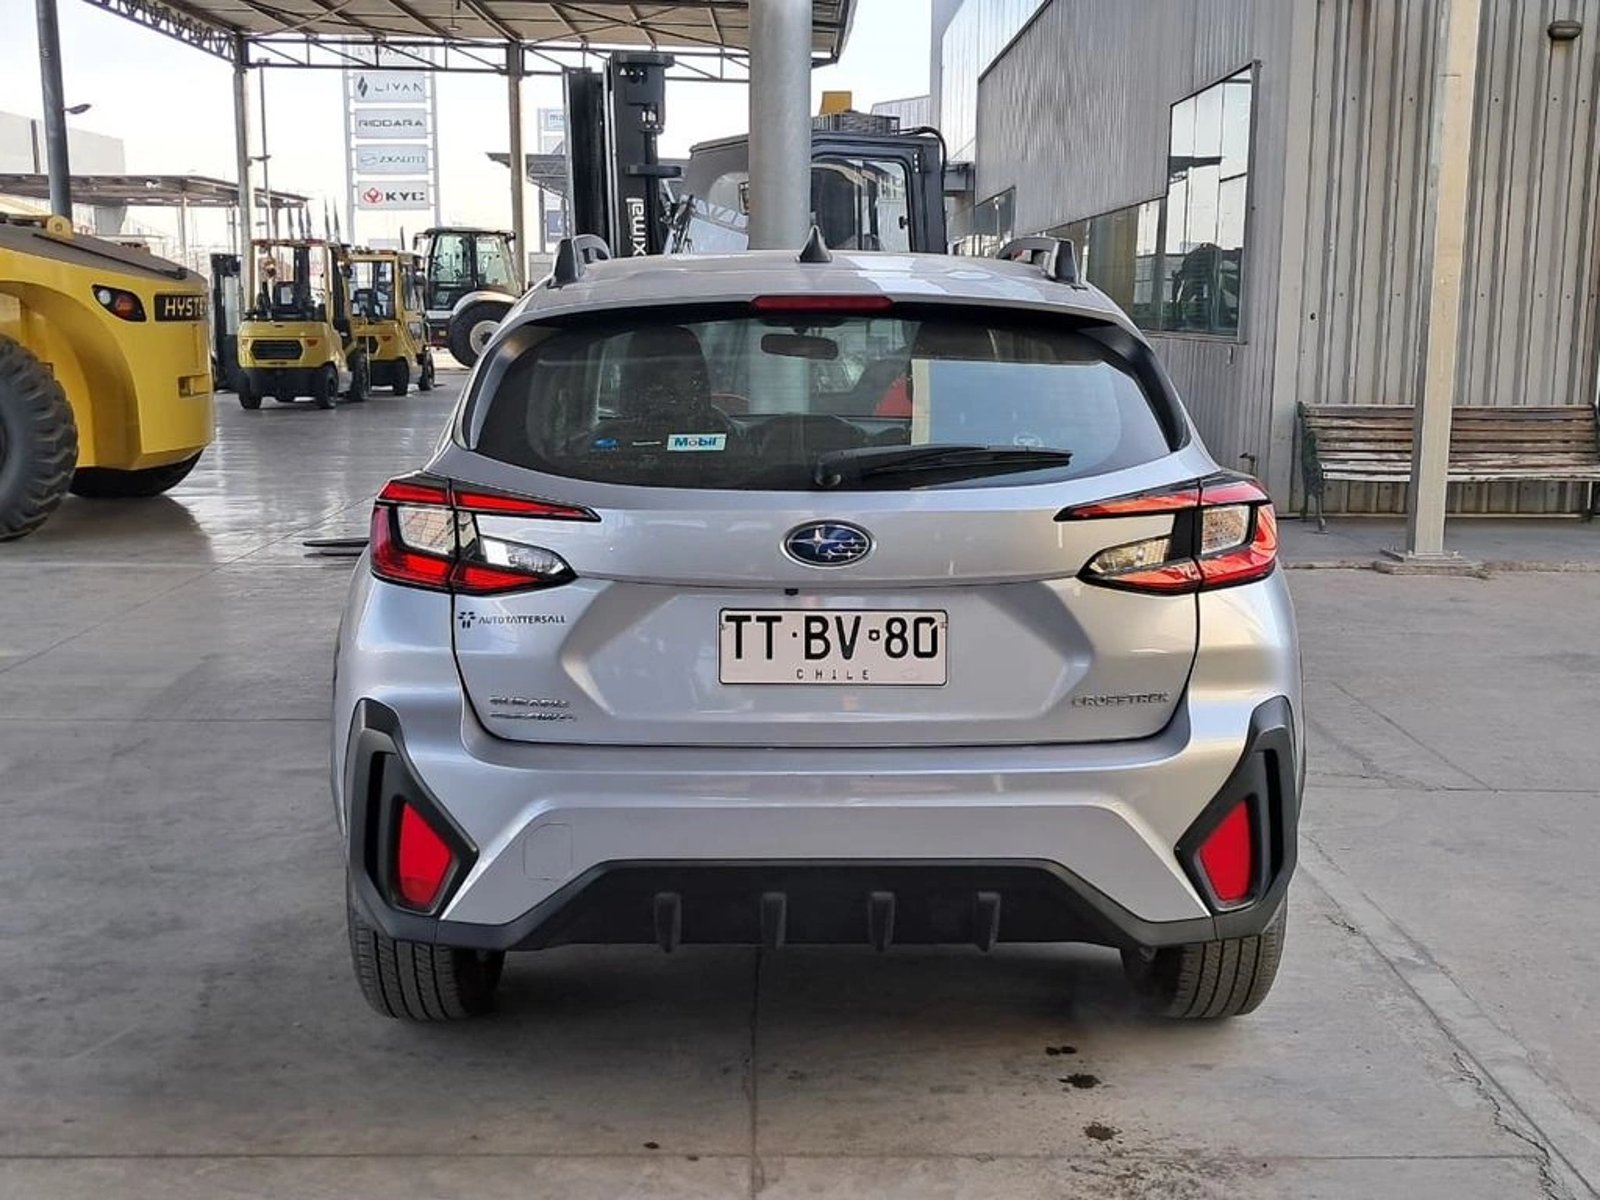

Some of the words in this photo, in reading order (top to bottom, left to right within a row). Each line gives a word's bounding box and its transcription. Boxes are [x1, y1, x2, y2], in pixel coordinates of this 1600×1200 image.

[374, 82, 423, 93] LIVAN
[385, 191, 425, 201] KYC
[626, 197, 647, 256] ximal
[164, 297, 207, 317] HYSTE
[674, 437, 717, 447] Mobil
[795, 668, 871, 681] CHILE
